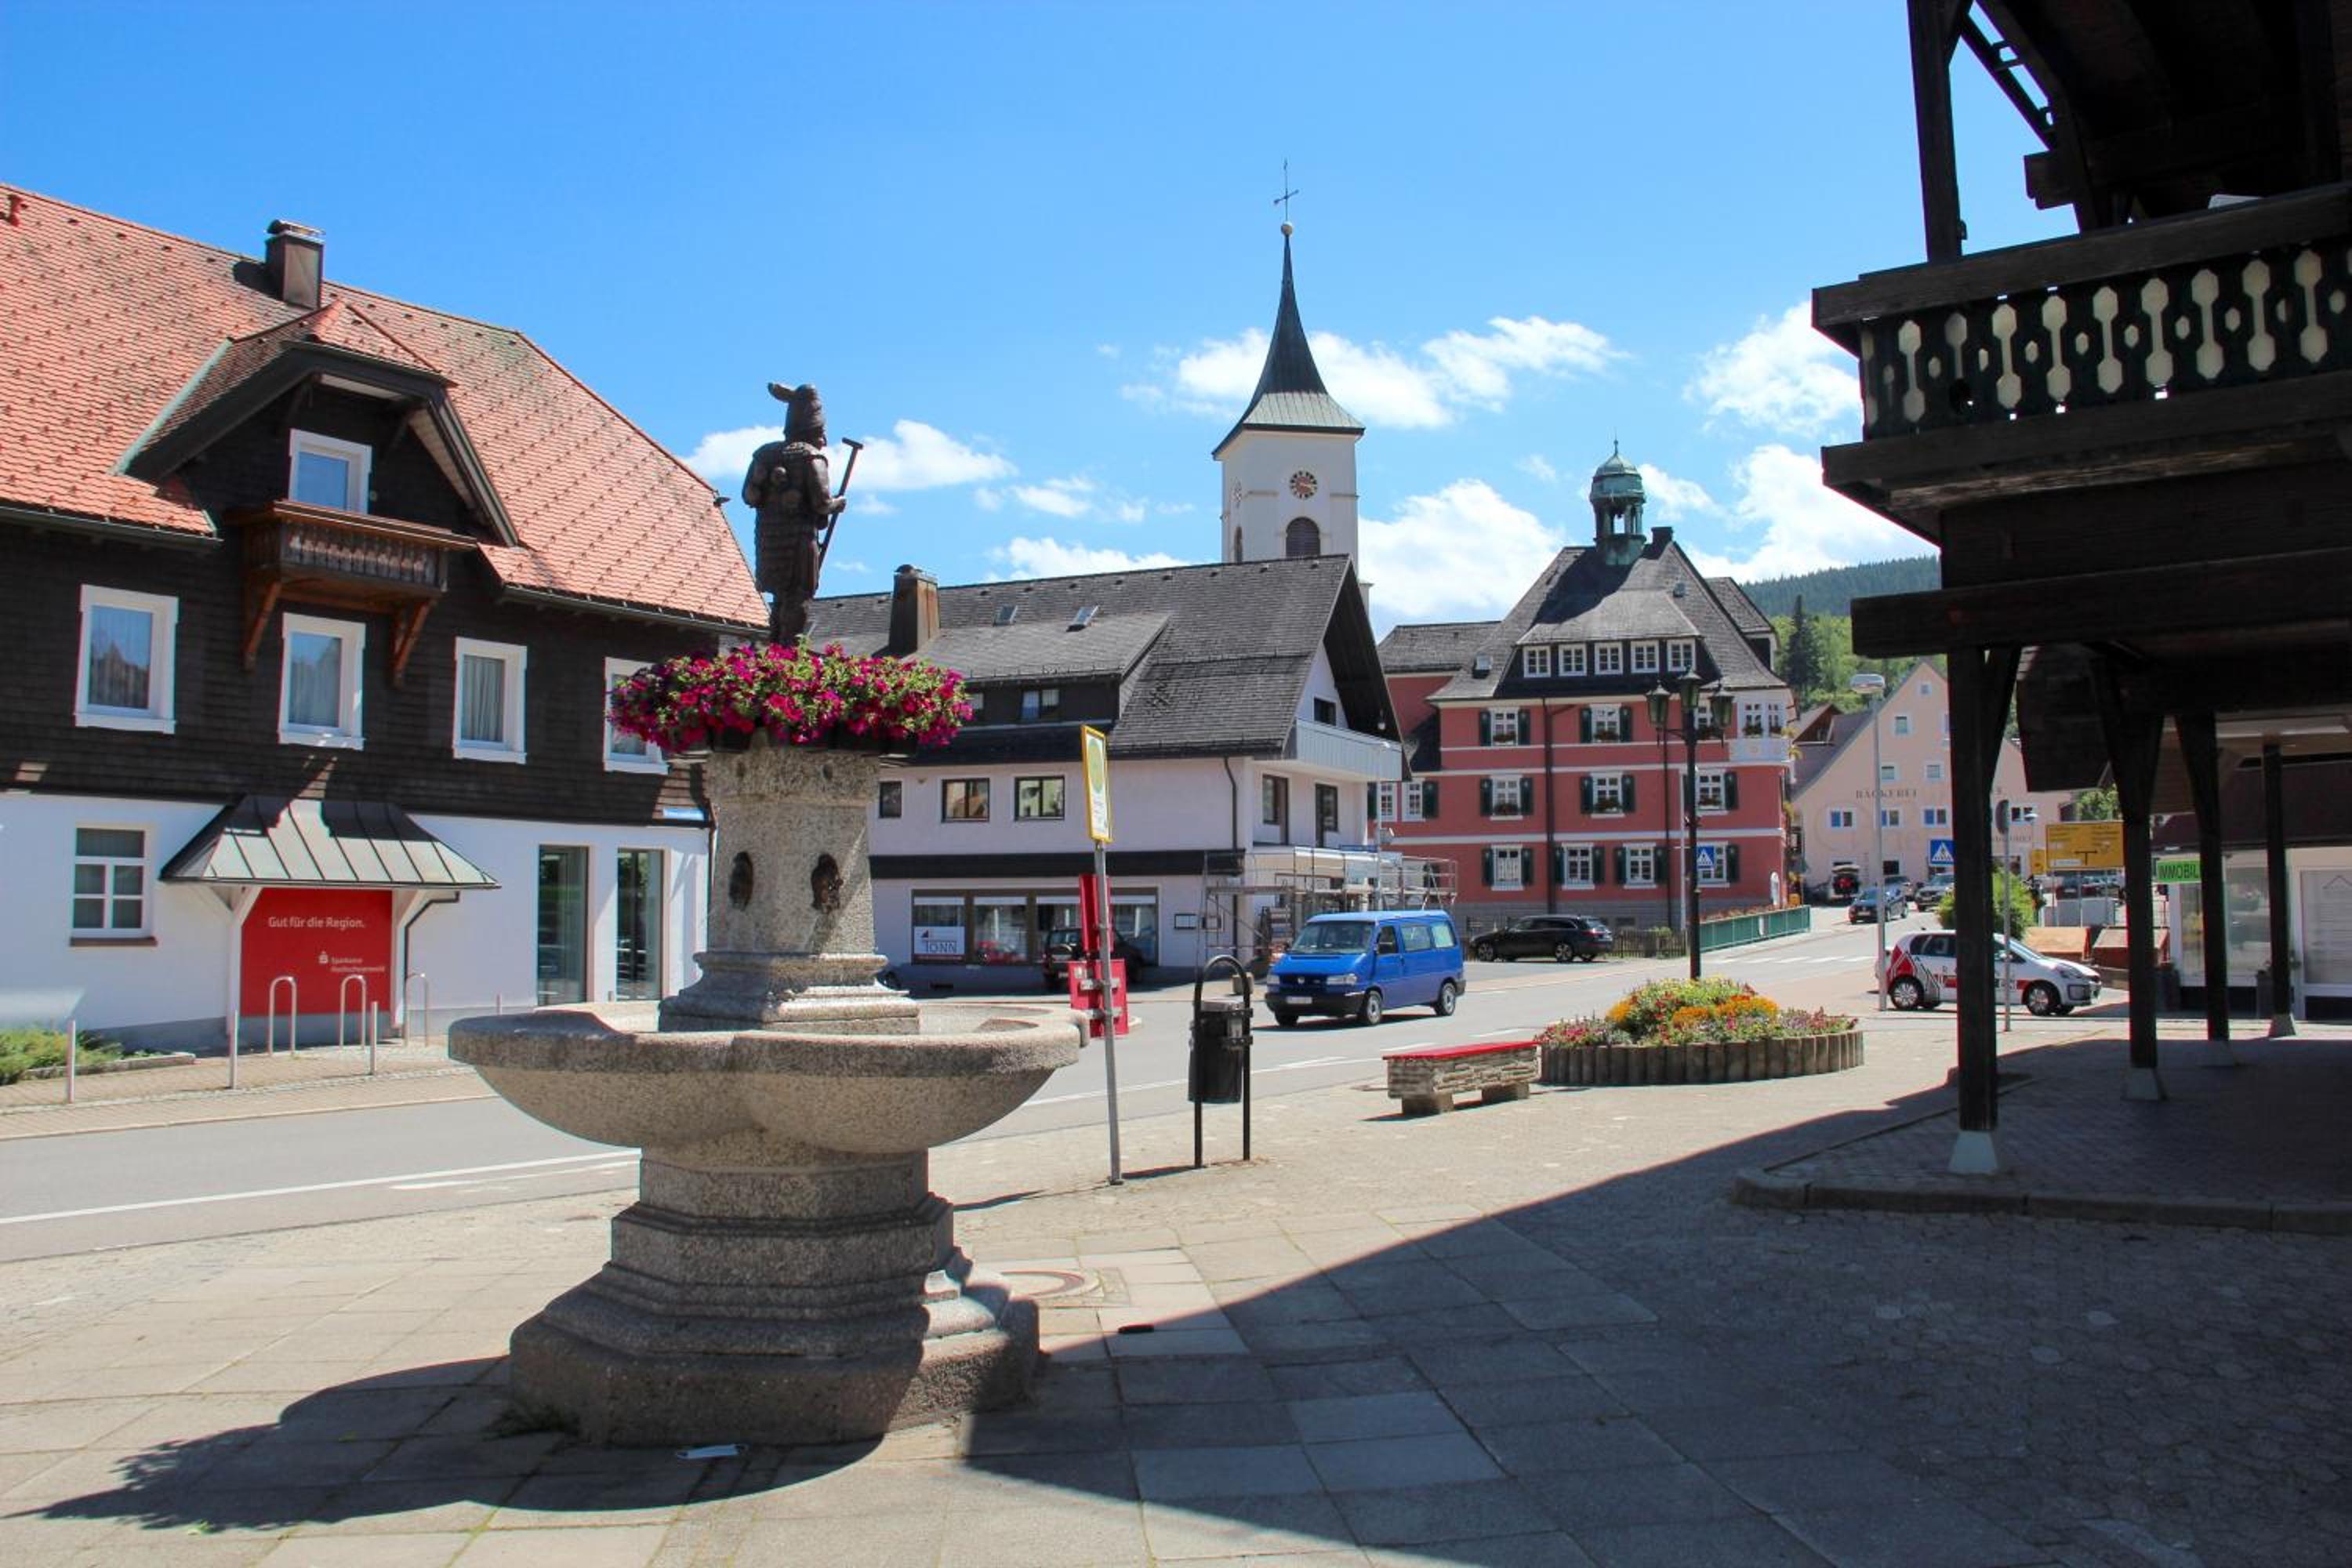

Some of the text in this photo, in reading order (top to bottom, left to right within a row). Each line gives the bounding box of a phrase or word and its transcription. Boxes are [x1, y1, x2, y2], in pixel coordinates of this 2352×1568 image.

[2158, 863, 2200, 879] IMMOBIL
[268, 916, 365, 931] Gut für die Region.
